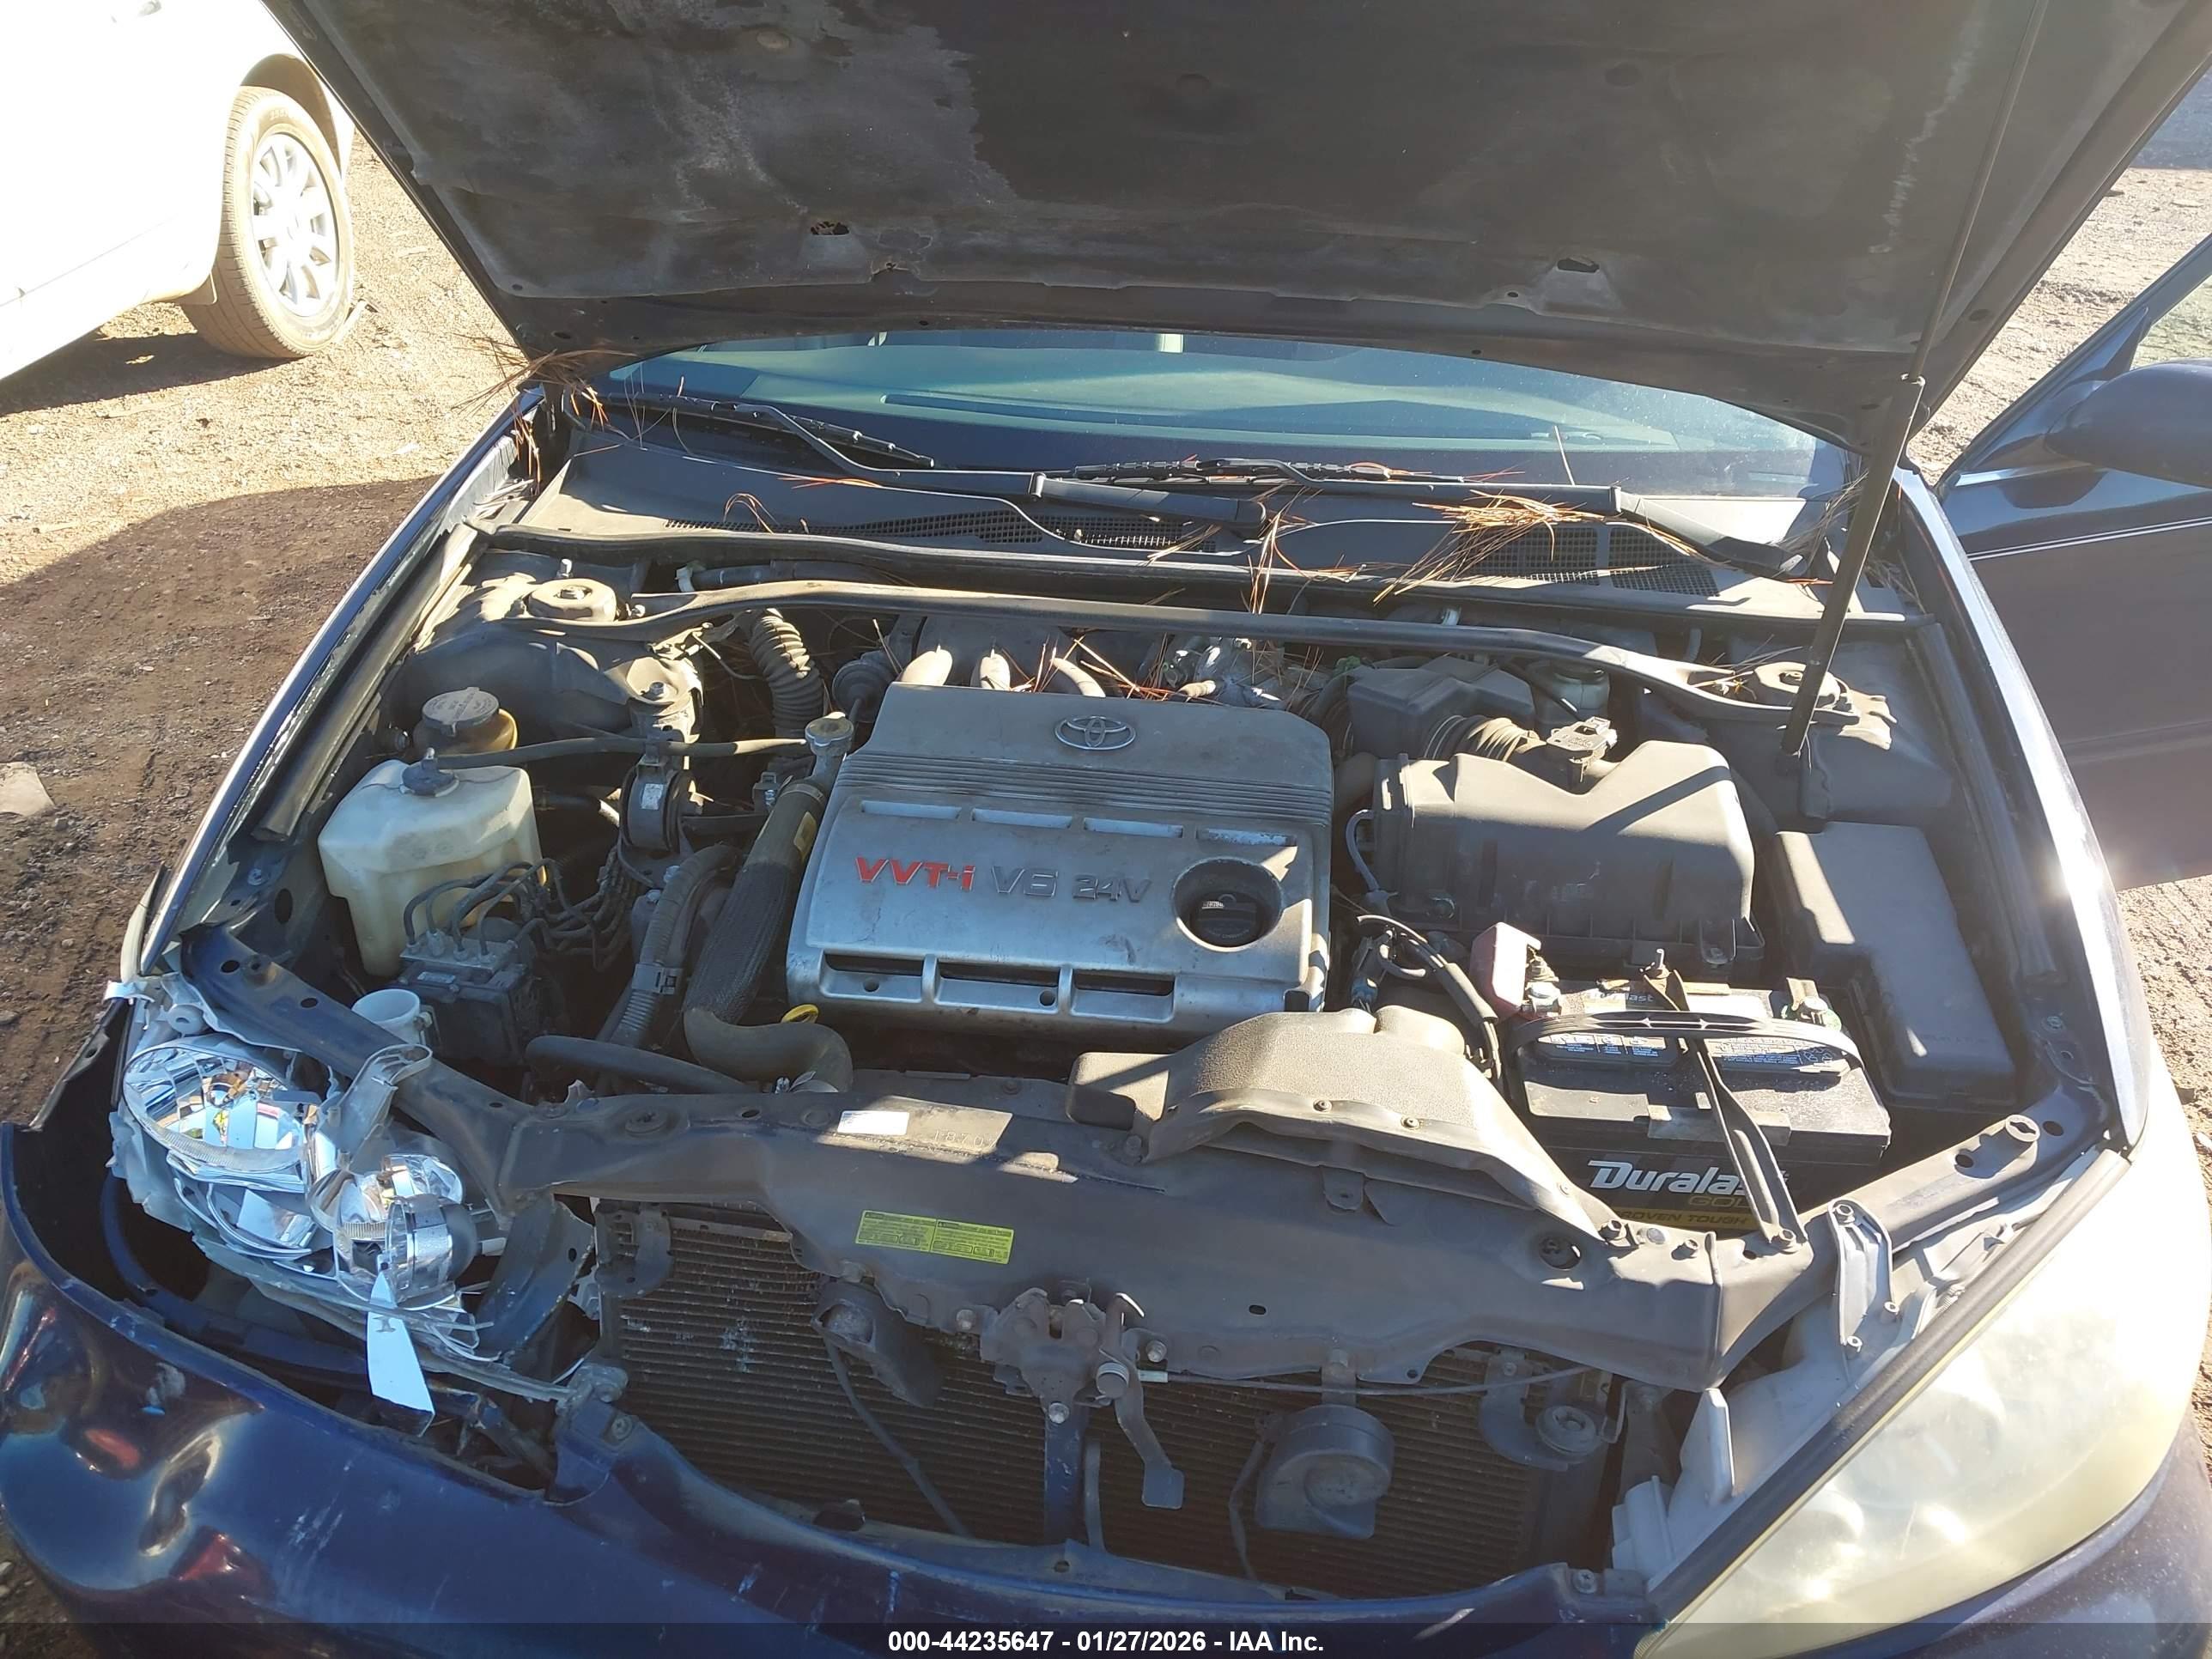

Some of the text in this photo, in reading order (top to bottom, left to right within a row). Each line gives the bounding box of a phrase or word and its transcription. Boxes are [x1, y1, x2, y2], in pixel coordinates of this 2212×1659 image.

[855, 857, 1152, 903] VVT-i V6 24V
[1588, 1160, 1790, 1196] Durala
[1688, 1195, 1749, 1209] GOL
[1687, 1213, 1747, 1225] TOUGH
